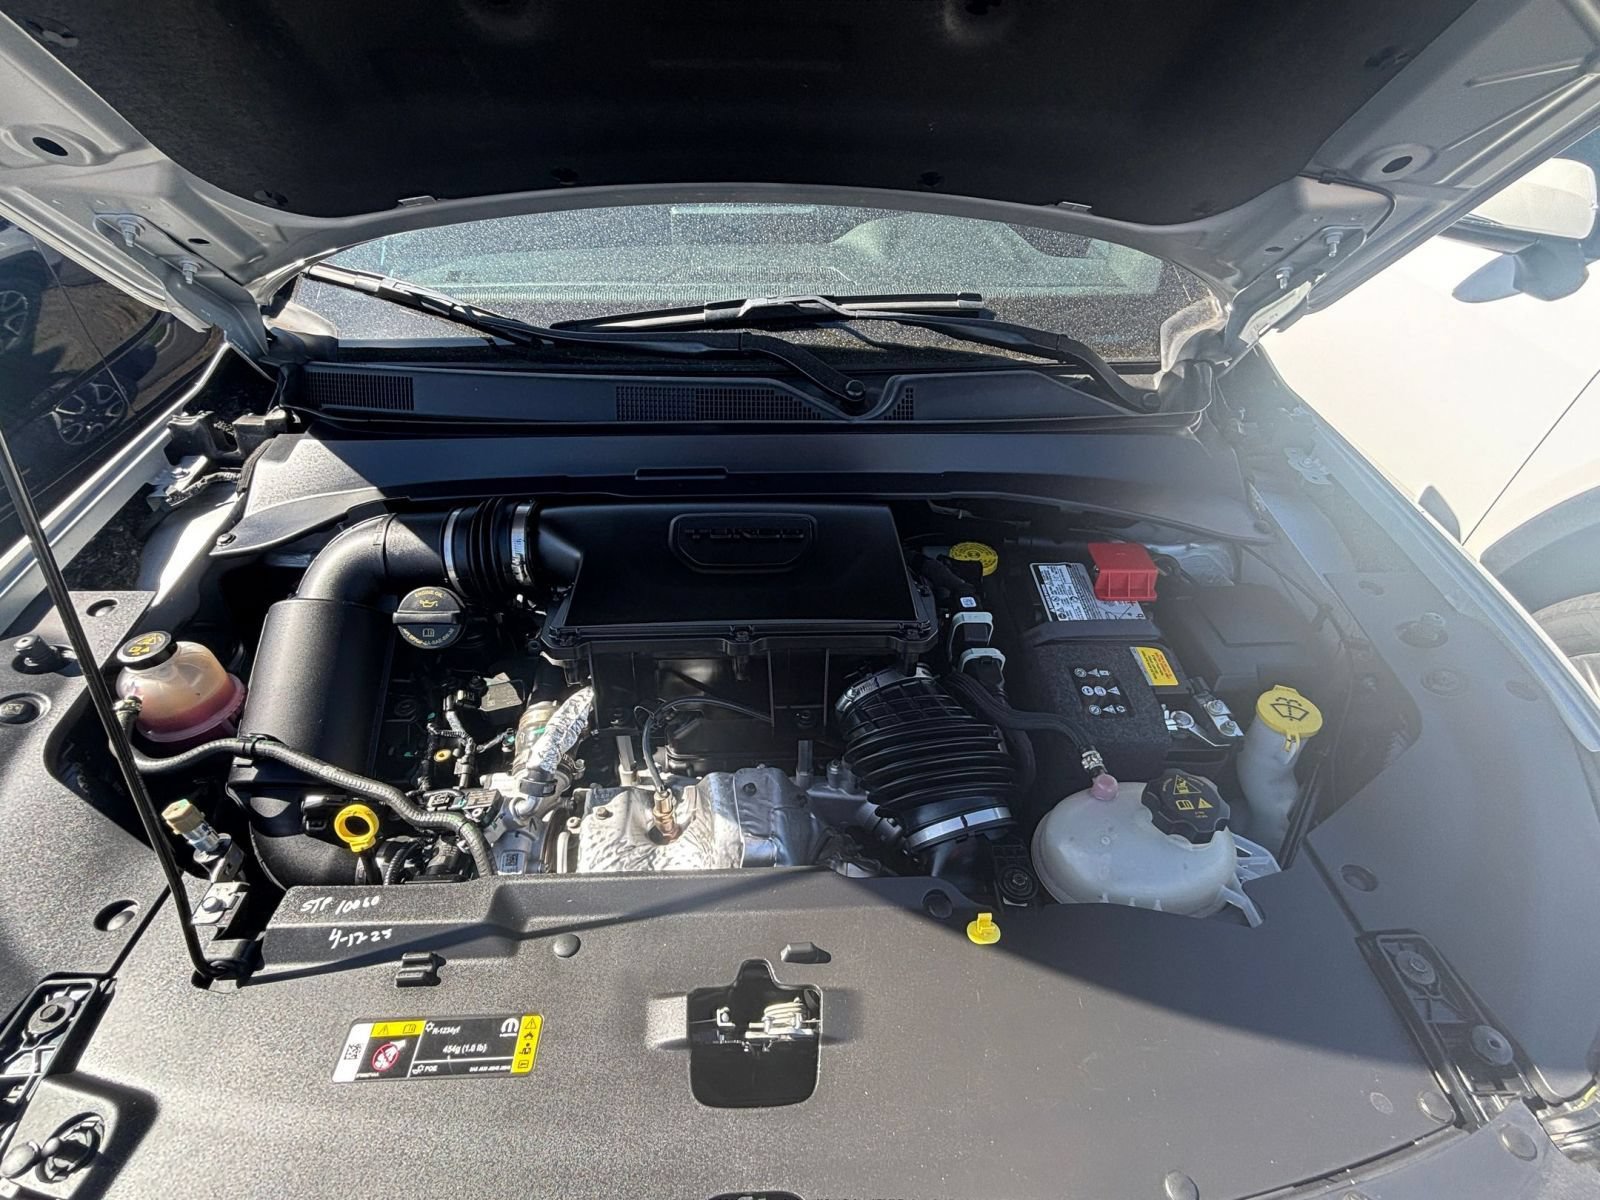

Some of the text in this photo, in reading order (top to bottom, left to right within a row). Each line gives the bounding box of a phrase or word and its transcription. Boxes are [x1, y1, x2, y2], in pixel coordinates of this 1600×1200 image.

[300, 896, 333, 914] STP
[442, 1044, 462, 1055] 454g
[476, 1043, 488, 1053] lb)
